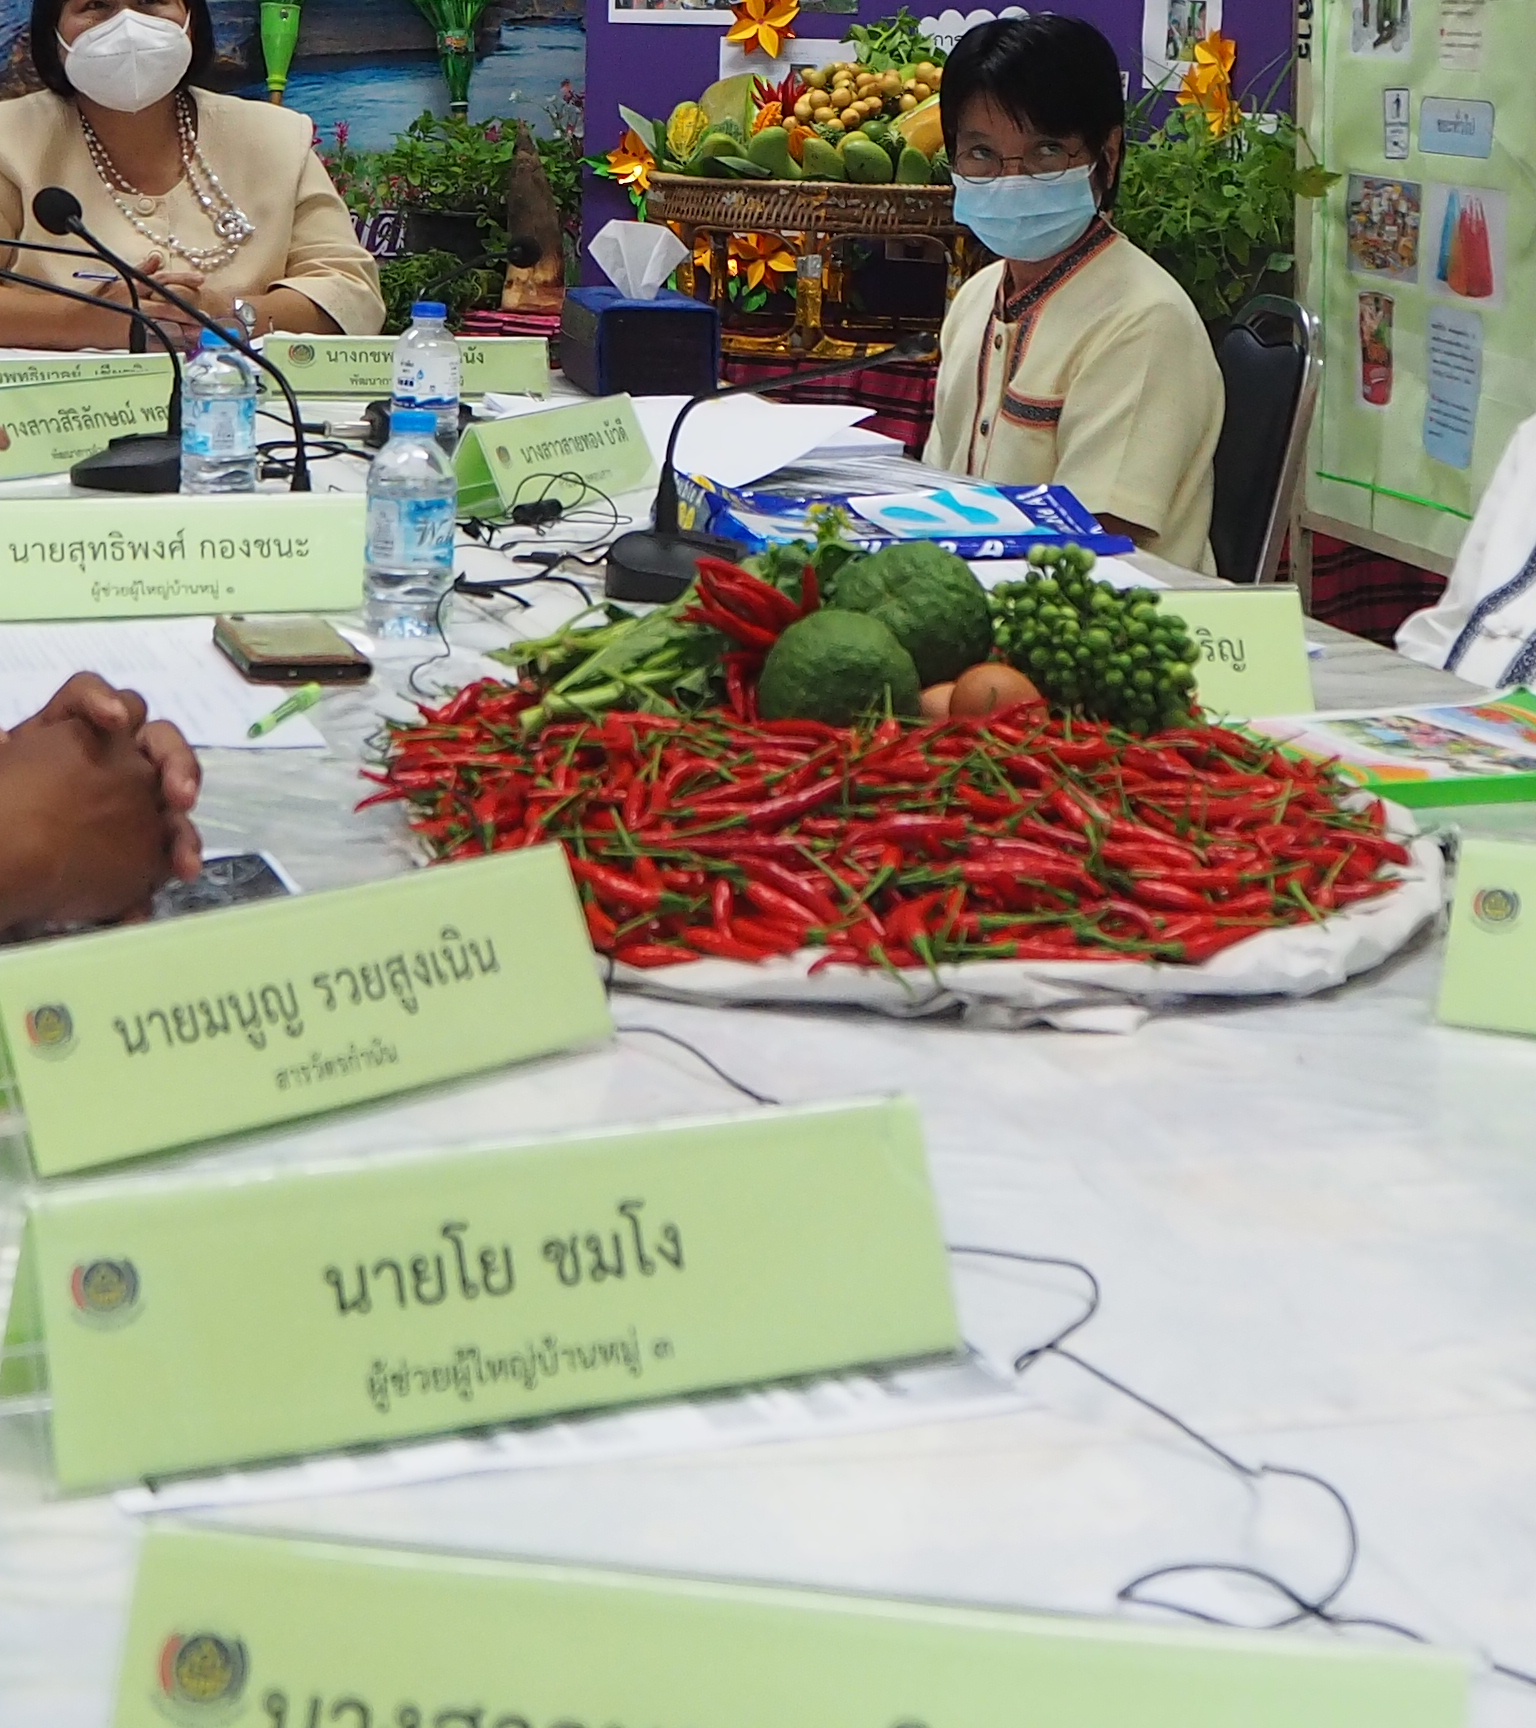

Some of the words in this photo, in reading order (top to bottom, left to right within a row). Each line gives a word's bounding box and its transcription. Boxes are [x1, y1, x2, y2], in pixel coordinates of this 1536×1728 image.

[8, 526, 188, 572] นายสุทธิพงศ์
[200, 534, 311, 563] กองชนะ
[90, 579, 221, 602] ผู้ช่วยผู้ใหญ่บ้านหมู่
[114, 978, 305, 1056] นายมนูญ
[313, 924, 502, 1016] รวยสูงเนิน
[323, 1219, 518, 1317] นายโย
[542, 1200, 688, 1288] ชมโง
[365, 1328, 642, 1414] ผู้ช่วยผู้ใหญ่บ้านหมู่
